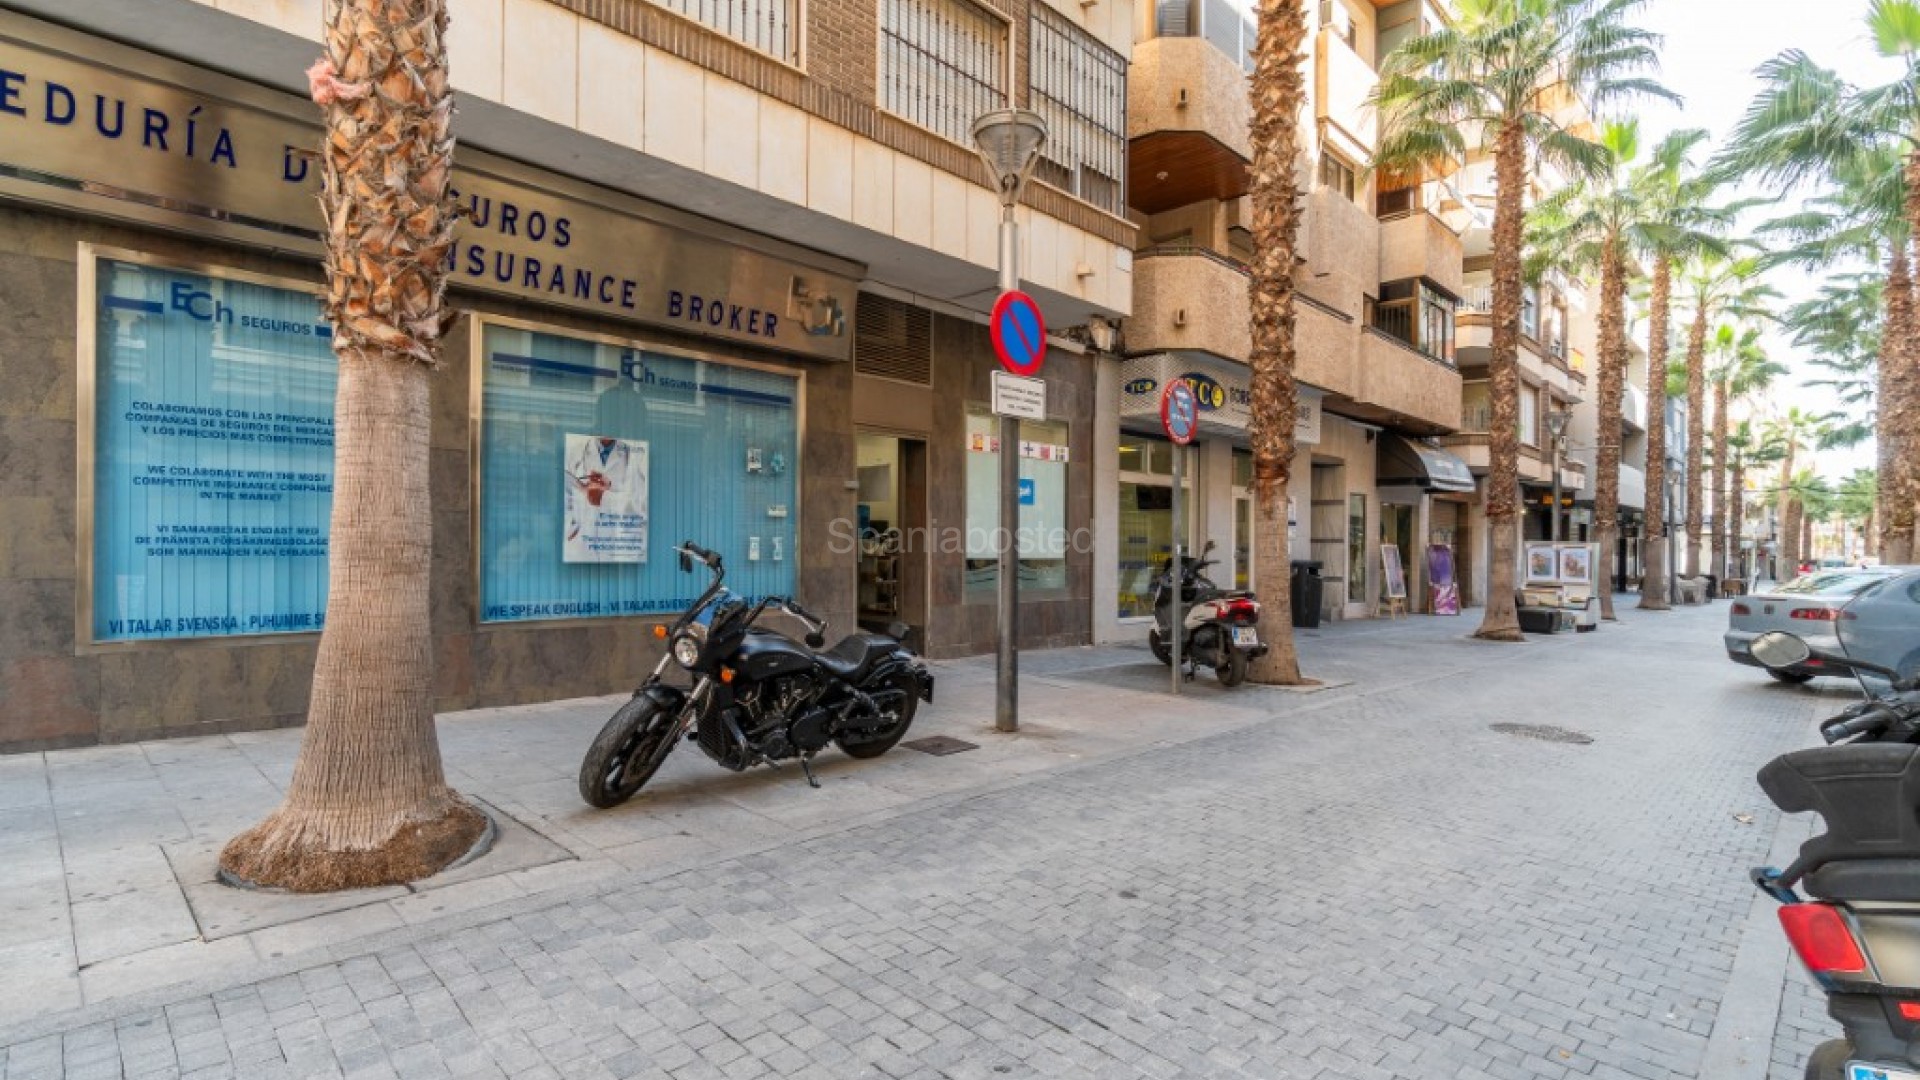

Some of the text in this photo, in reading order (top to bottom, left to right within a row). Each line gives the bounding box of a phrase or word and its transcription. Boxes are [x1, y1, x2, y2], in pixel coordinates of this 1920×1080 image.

[450, 189, 571, 247] UROS
[668, 290, 778, 337] BROKER
[241, 316, 312, 335] SEGUROS
[132, 401, 222, 417] COLABORAMOS
[226, 409, 248, 418] CON
[253, 411, 272, 420] LAS
[201, 419, 214, 427] DE
[219, 420, 270, 431] SEGUROS
[153, 426, 175, 436] LOS
[179, 428, 227, 440] PRECIOS
[148, 465, 165, 475] WE
[169, 466, 244, 478] COLABORATE
[247, 471, 272, 480] WITH
[133, 476, 210, 488] COMPETITIVE
[200, 491, 212, 499] IN
[216, 491, 234, 500] THE
[488, 605, 507, 617] WE
[510, 604, 550, 617] SPEAK
[109, 619, 122, 634] VI
[127, 619, 172, 633] TALAR
[177, 616, 237, 632] SVENSKA
[250, 613, 311, 629] PUHUMME
